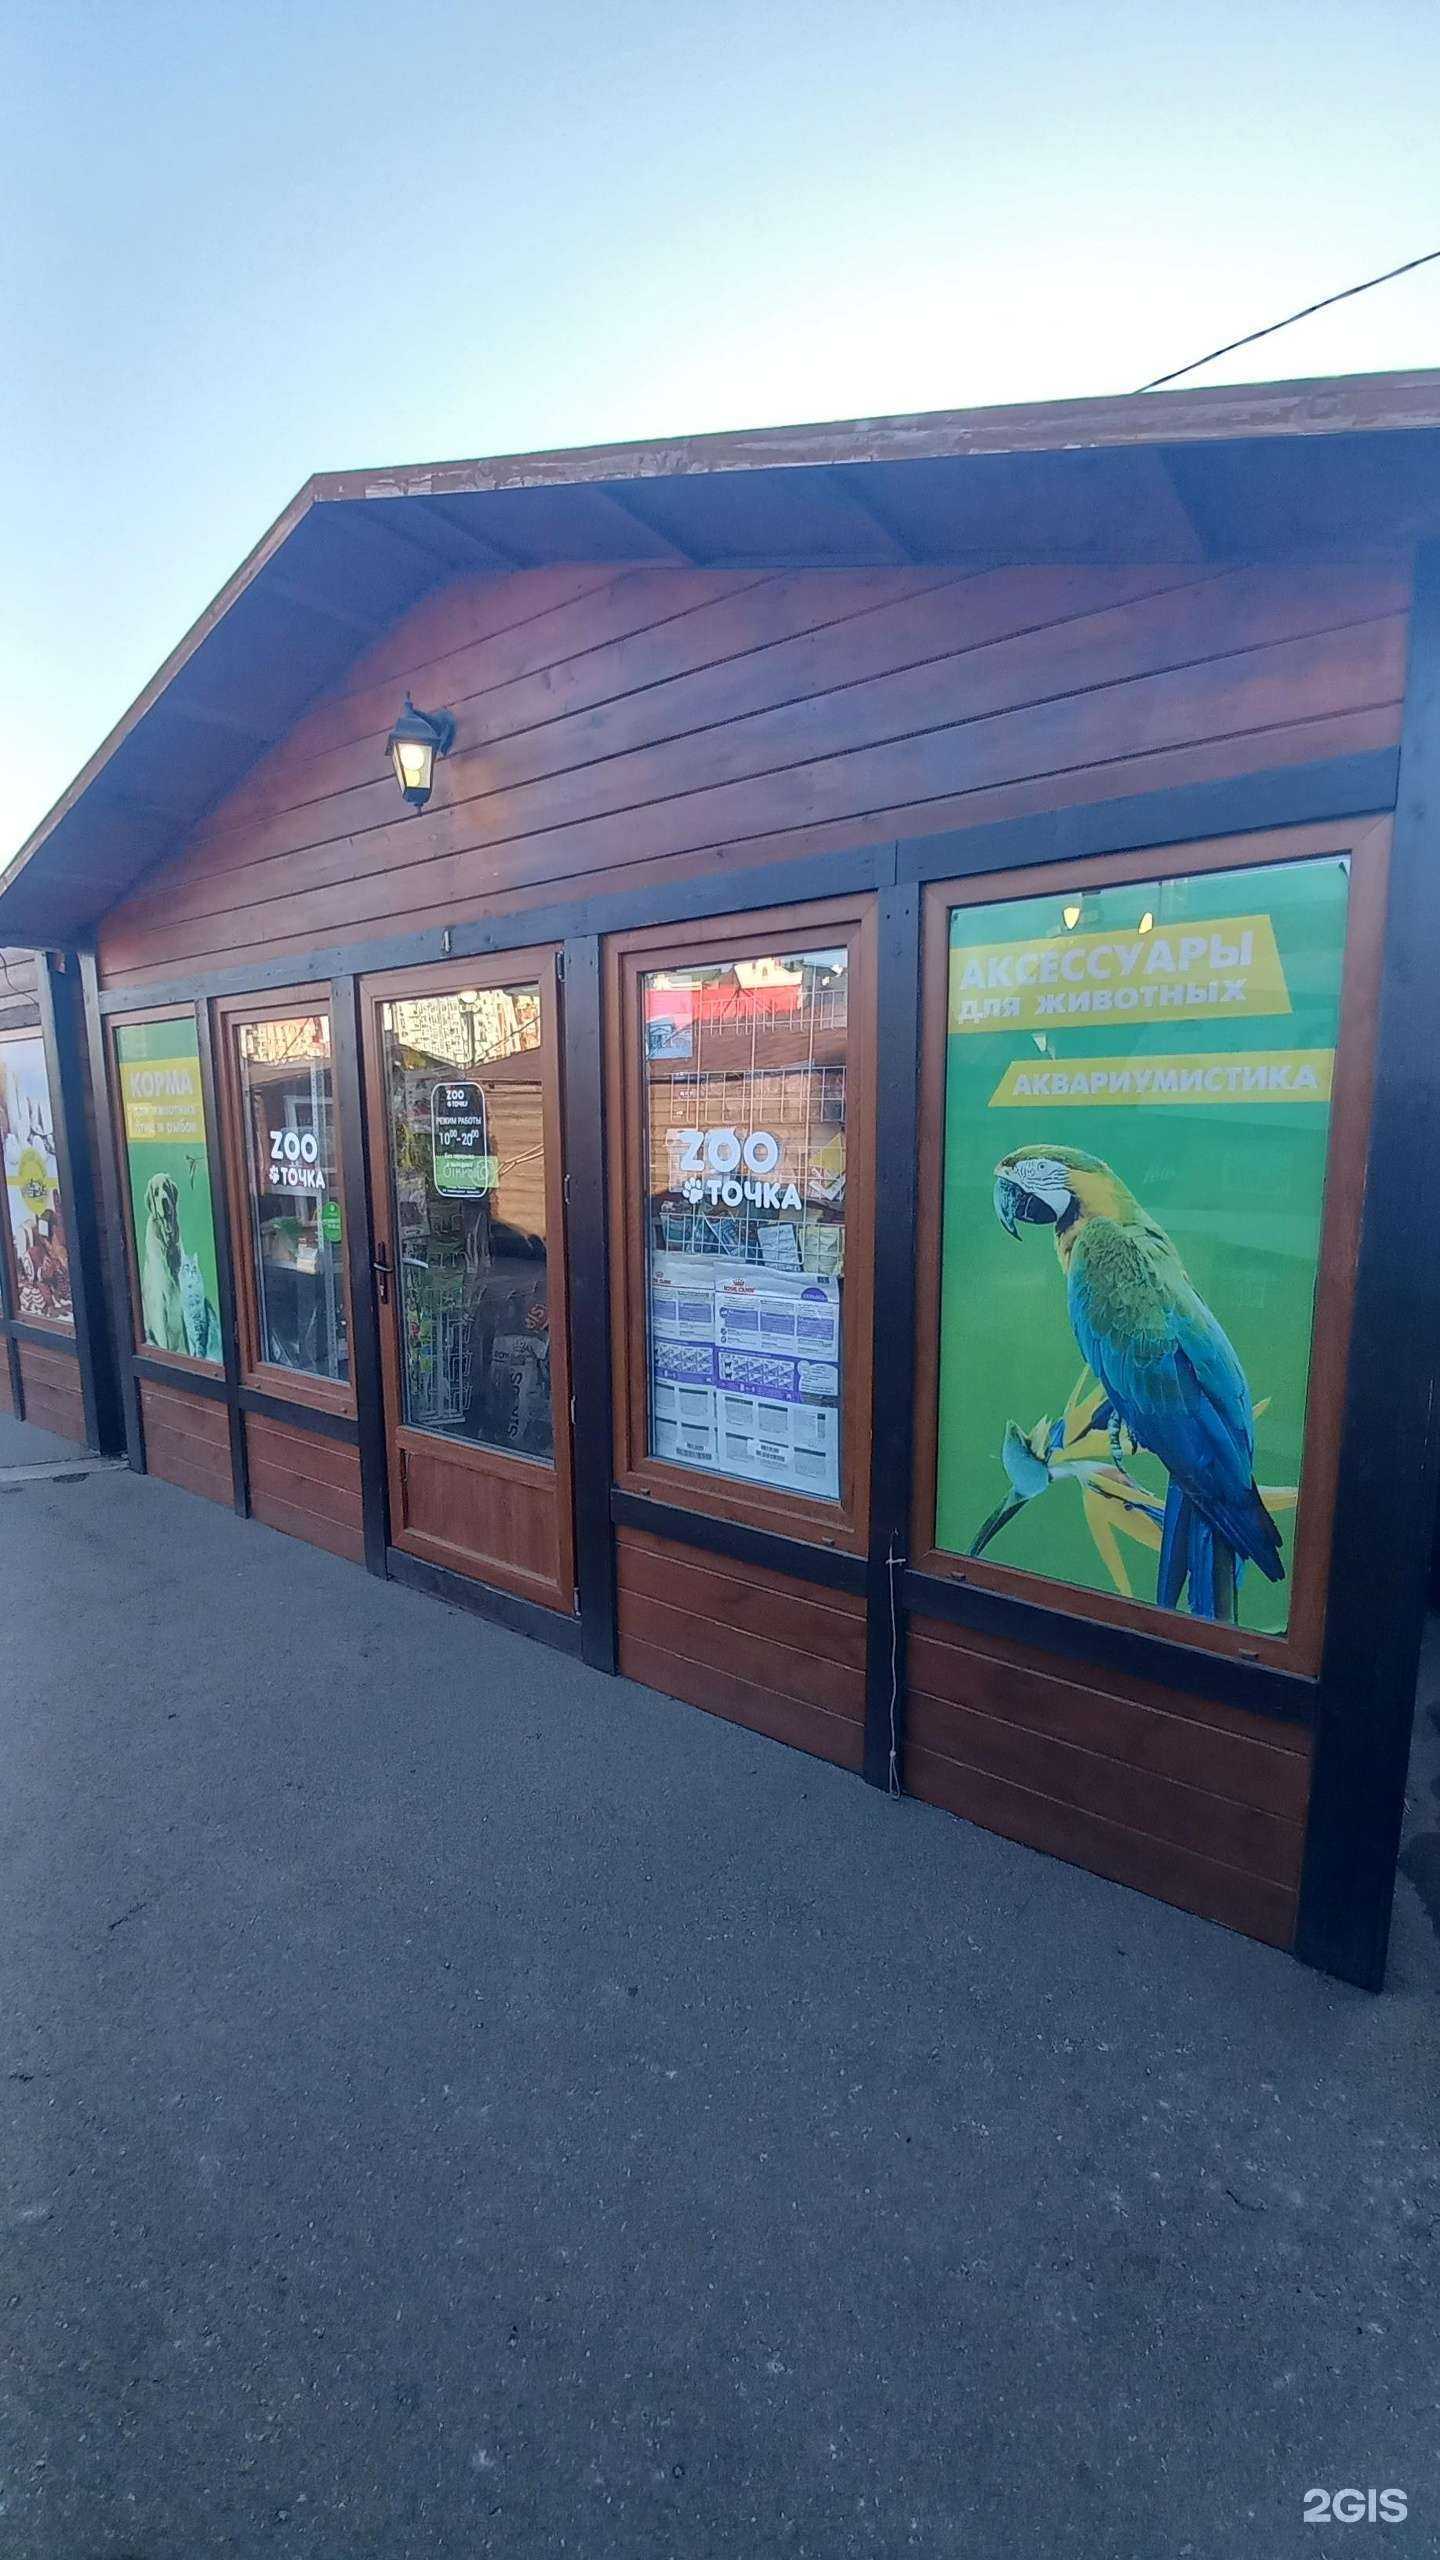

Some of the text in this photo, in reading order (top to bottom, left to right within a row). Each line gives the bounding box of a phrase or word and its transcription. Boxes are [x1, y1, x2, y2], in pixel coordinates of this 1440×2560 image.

[959, 930, 1254, 991] АКСЕССУАРЫ
[130, 1070, 193, 1097] КОРМА
[446, 1090, 465, 1100] ZOO
[1011, 1065, 1319, 1097] АКВАРИУМИСТИКА
[458, 1117, 482, 1125] РАБОТЫ
[270, 1130, 318, 1163] ZOO
[679, 1130, 779, 1174] ZOO
[280, 1167, 326, 1189] ТОЧКА
[706, 1180, 803, 1210] ТОЧКА
